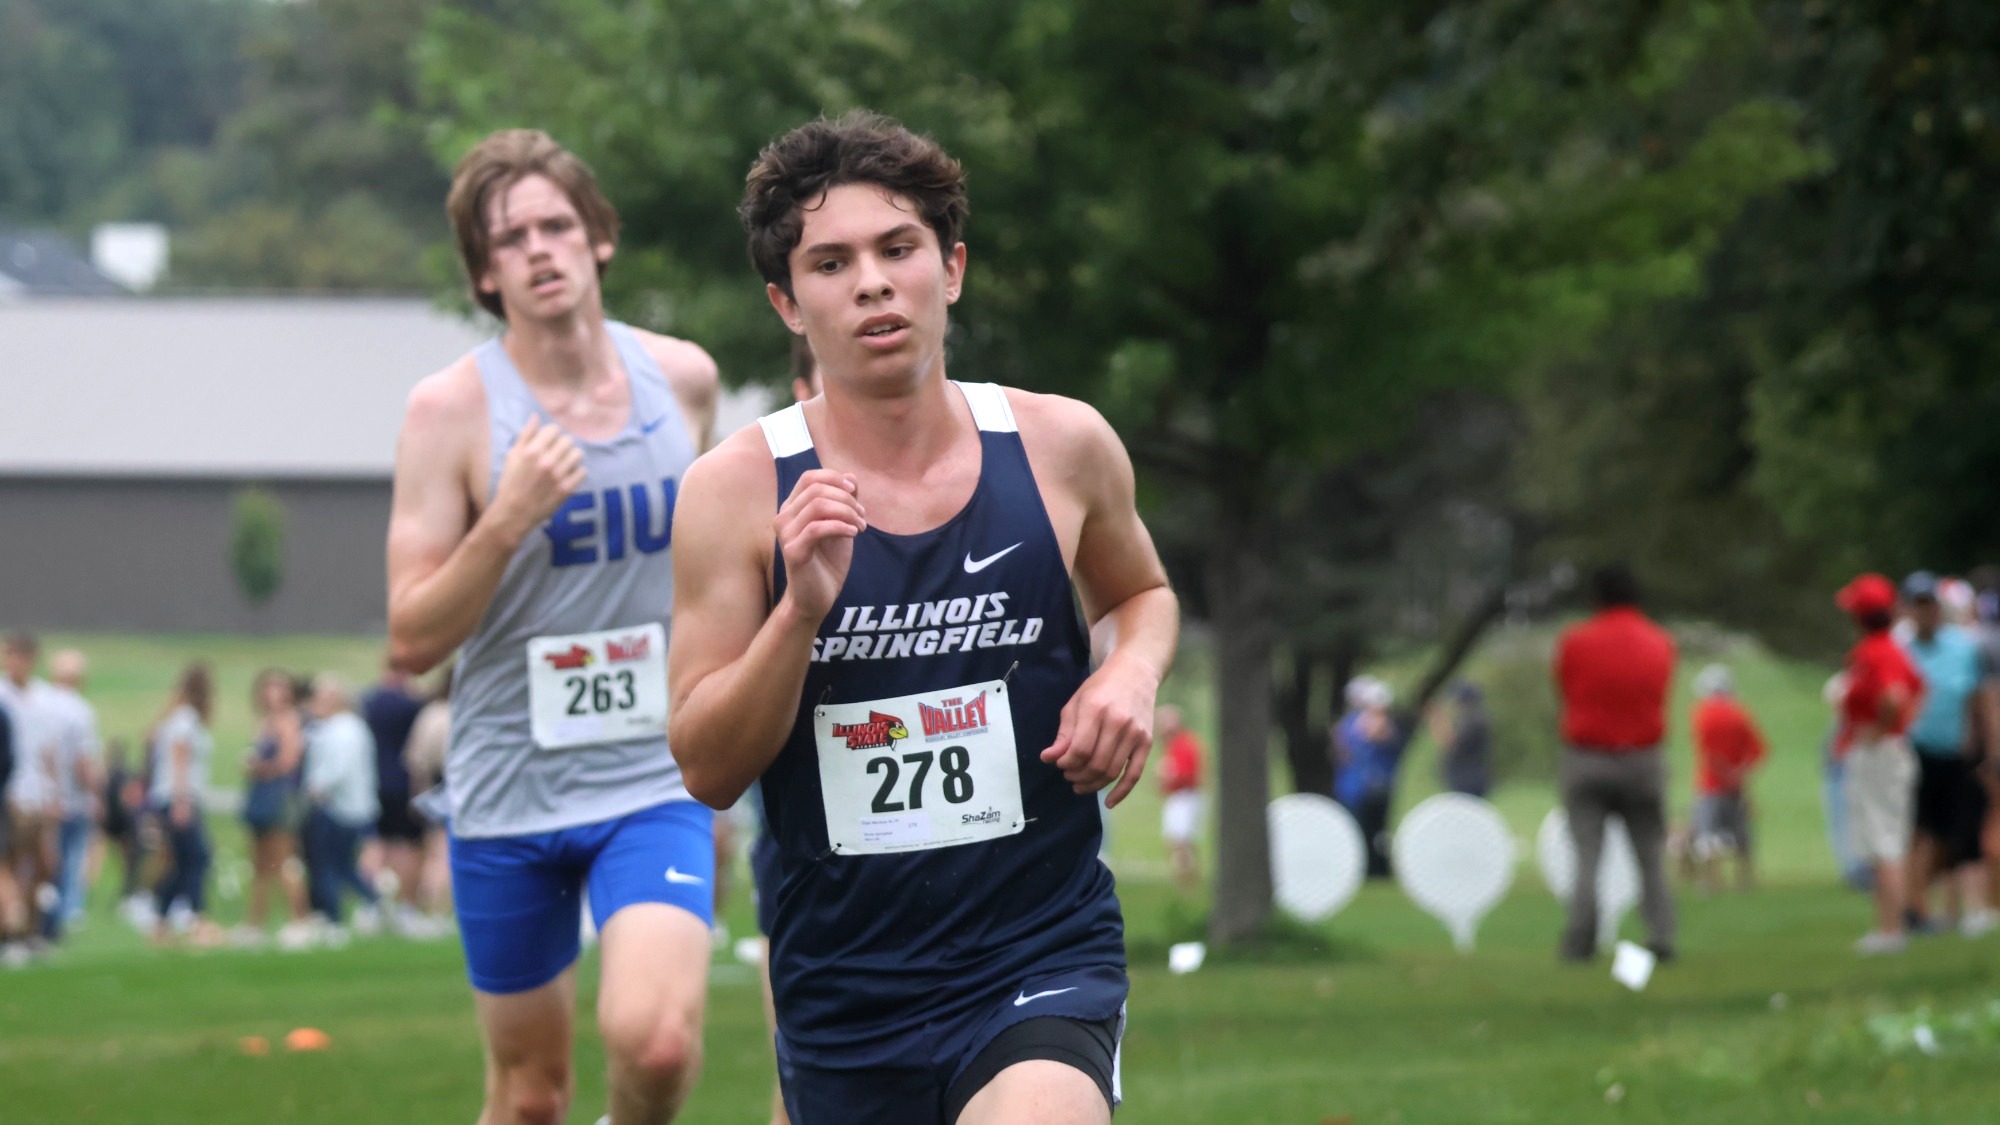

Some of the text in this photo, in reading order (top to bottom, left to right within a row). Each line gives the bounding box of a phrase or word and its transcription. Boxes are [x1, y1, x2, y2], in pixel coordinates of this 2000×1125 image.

[544, 477, 677, 567] EIU
[836, 592, 1010, 632] ILLINOIS
[565, 669, 636, 716] 263
[941, 696, 963, 708] THE
[832, 722, 889, 737] ILLINOIS
[918, 690, 987, 736] VALLEY
[847, 733, 888, 748] STATE
[866, 745, 974, 813] 278
[961, 810, 1001, 824] ShaZam
